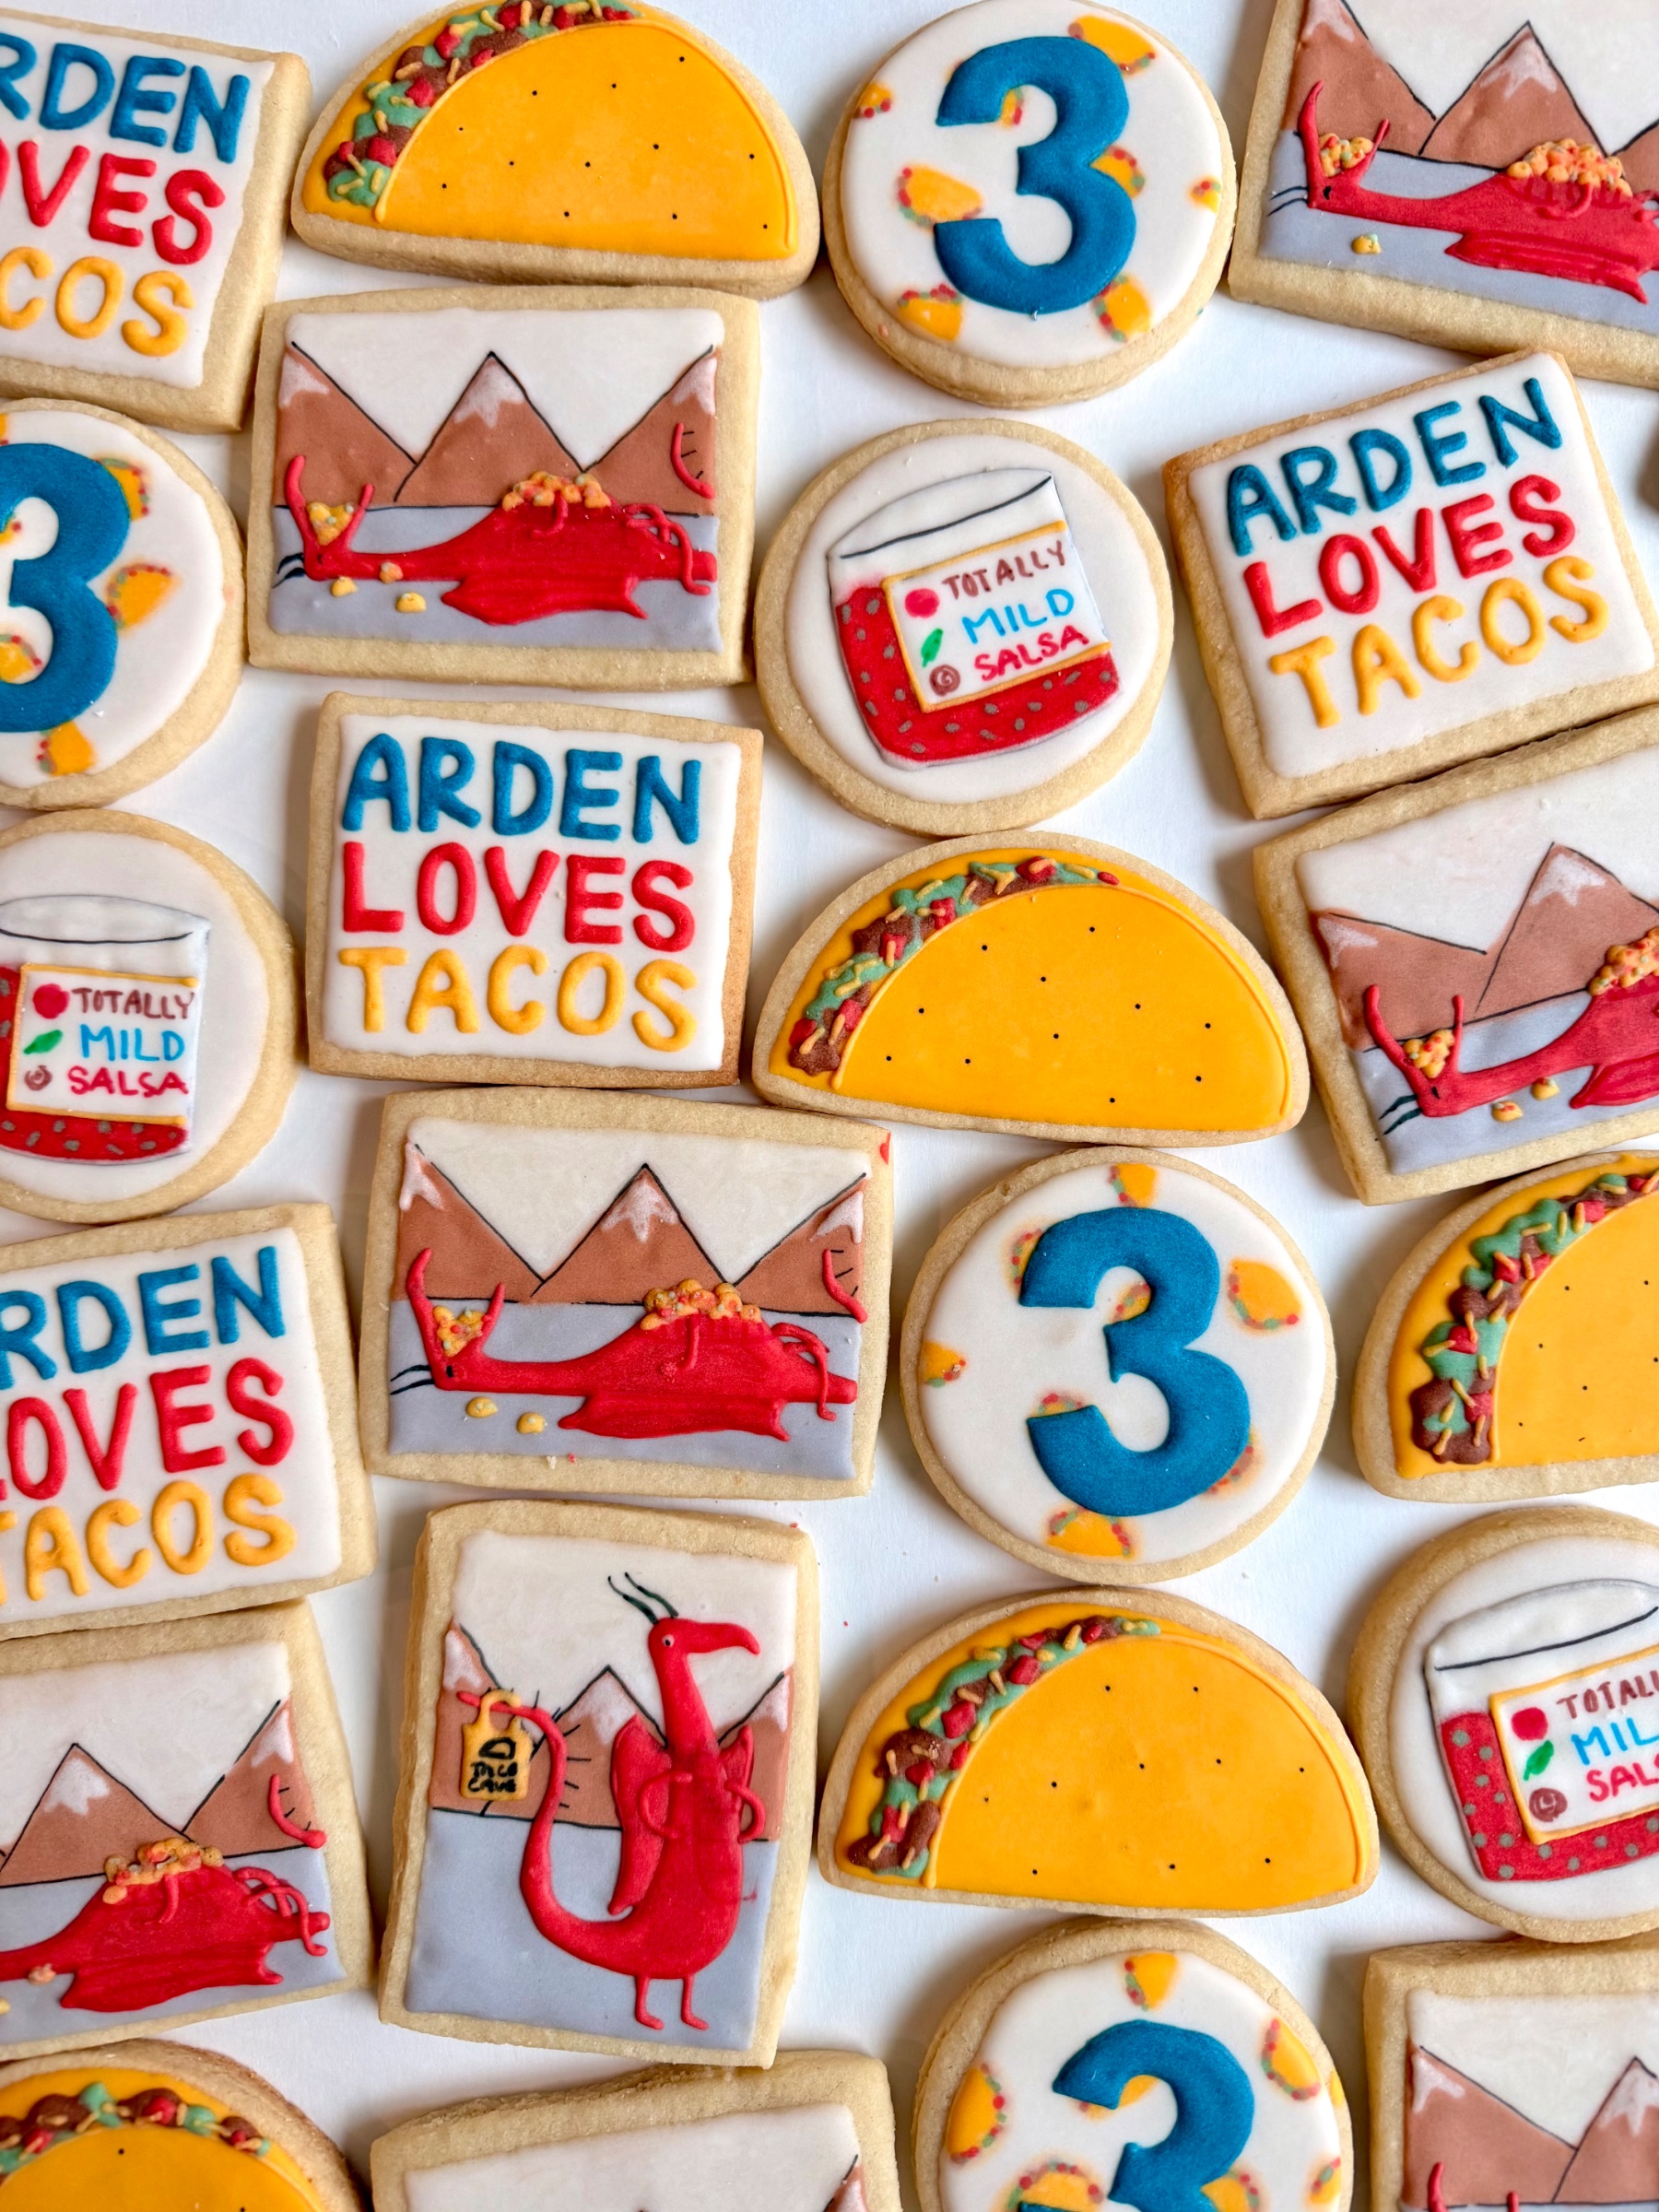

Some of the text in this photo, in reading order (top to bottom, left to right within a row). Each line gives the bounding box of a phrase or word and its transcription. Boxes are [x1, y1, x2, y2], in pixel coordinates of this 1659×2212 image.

[0, 136, 226, 265] VES
[934, 36, 1136, 315] 3
[1227, 377, 1562, 557] ARDEN
[0, 442, 131, 733] 3
[942, 540, 1065, 600] TOTALLY
[961, 589, 1075, 643] MILD
[1243, 474, 1575, 638] LOVES
[974, 625, 1089, 681] SALSA
[1269, 556, 1608, 728] TACOS
[342, 733, 701, 844] ARDEN
[343, 841, 696, 952] LOVES
[71, 987, 194, 1019] TOTALLY
[79, 1024, 185, 1062] MILD
[339, 945, 699, 1053] TACOS
[67, 1065, 189, 1098] SALSA
[1018, 1206, 1251, 1517] 3
[0, 1358, 294, 1500] OVES
[0, 1473, 296, 1605] ACOS
[1585, 1753, 1659, 1802] SAL
[1018, 2018, 1254, 2212] 3
